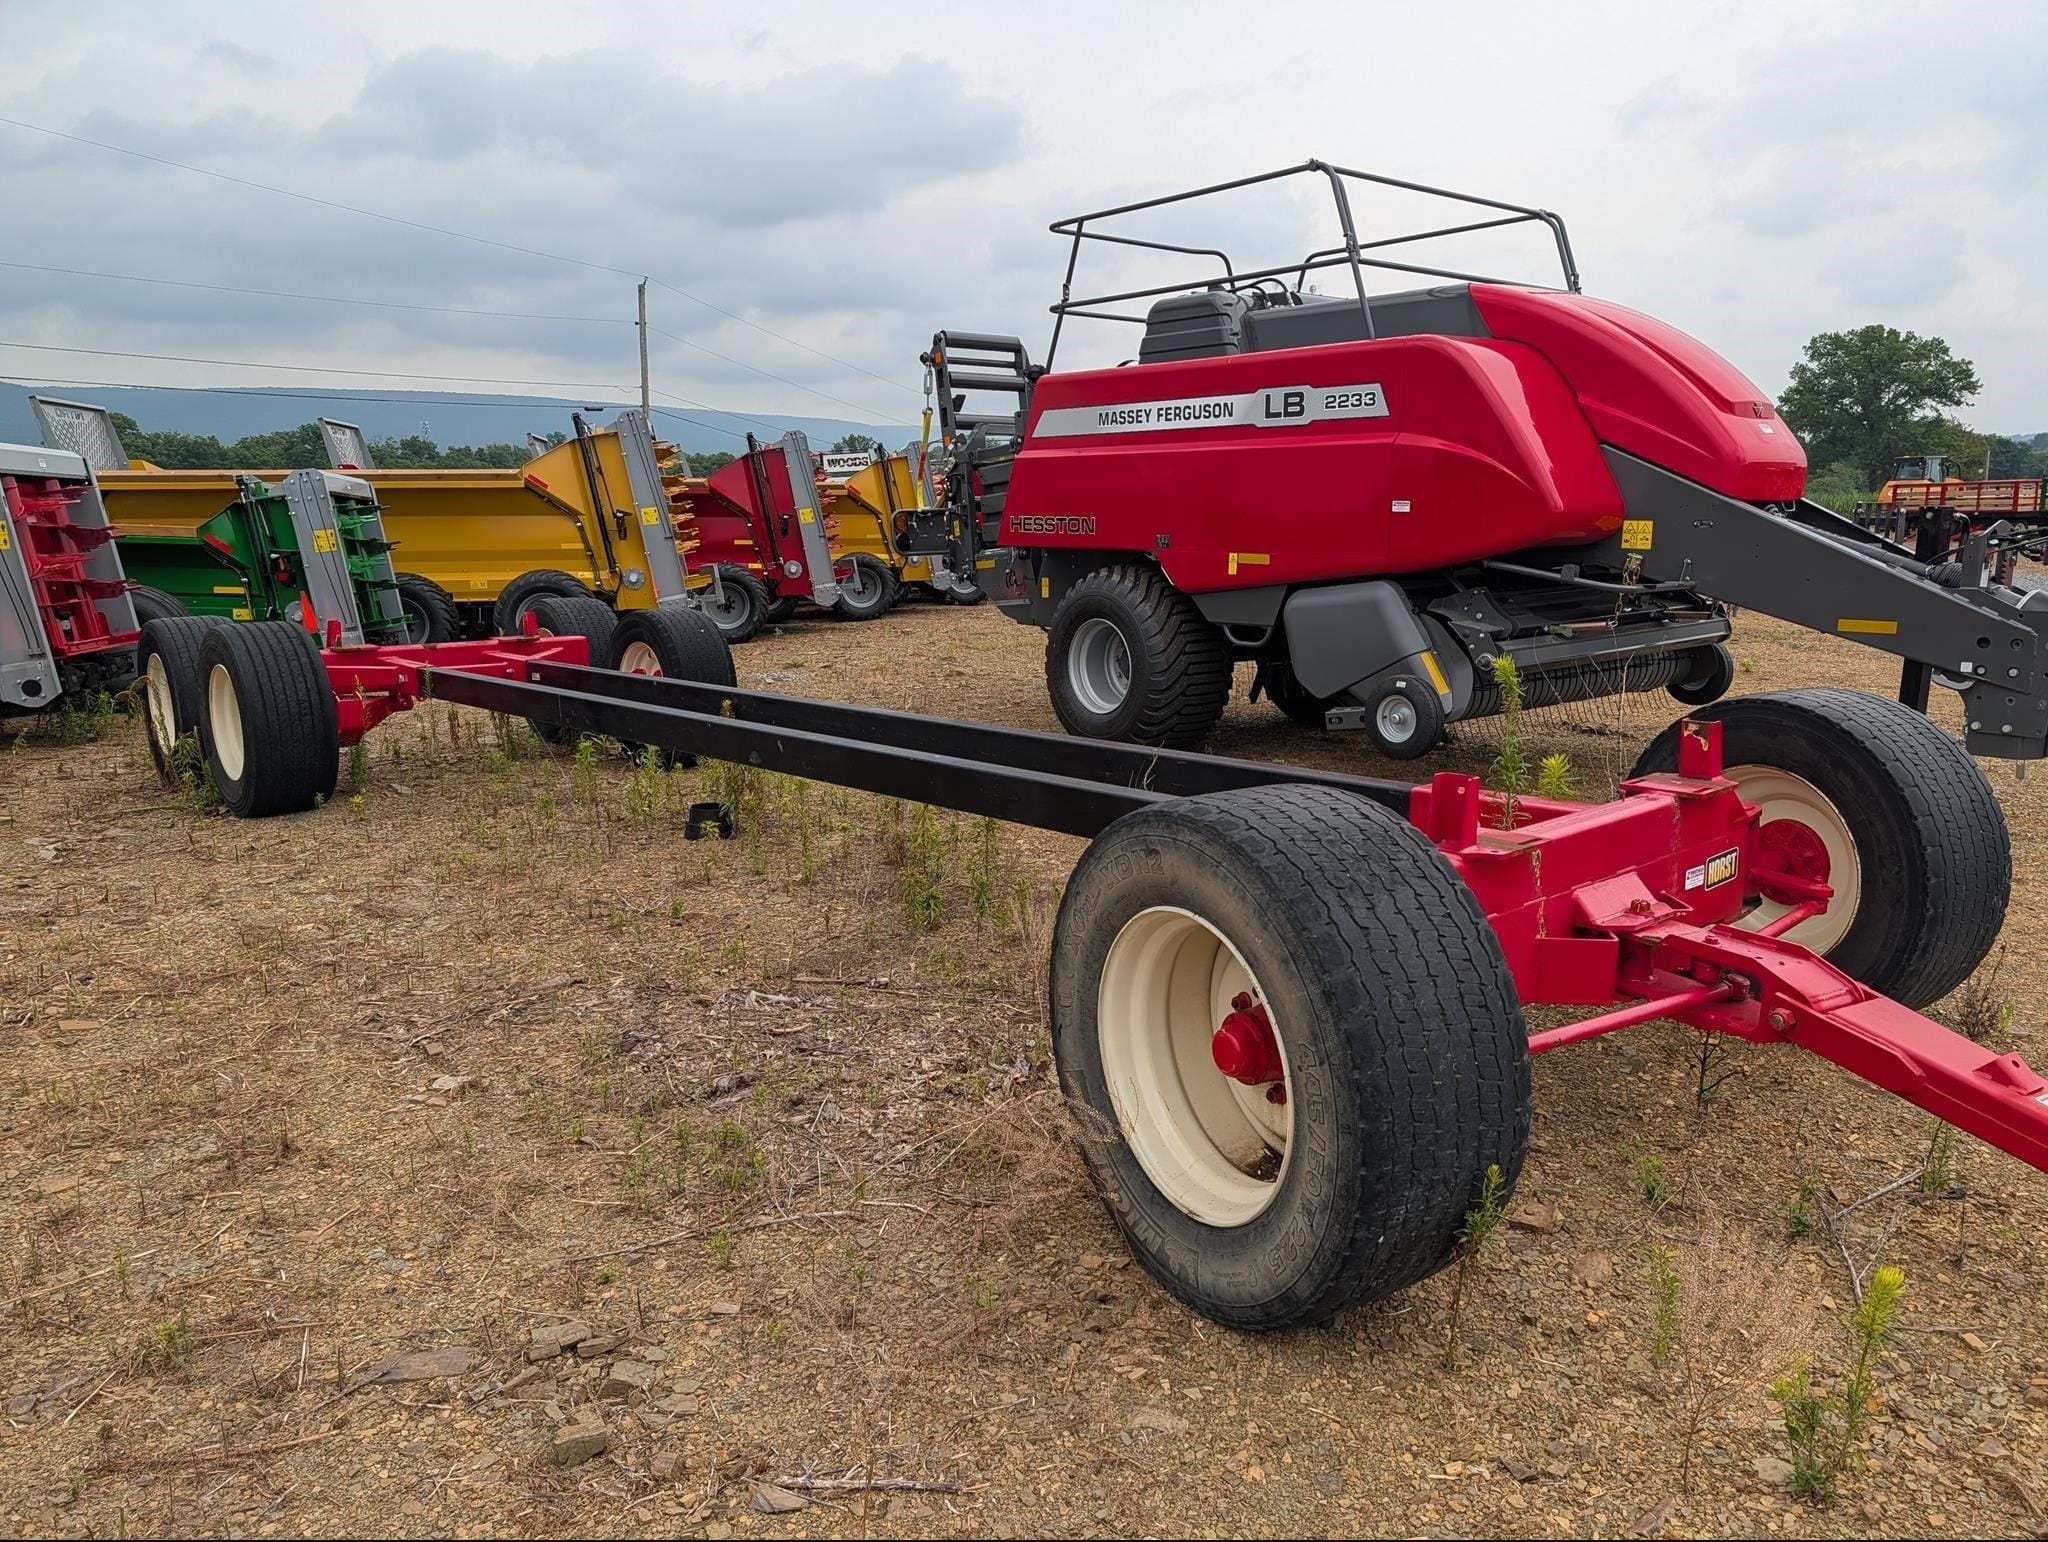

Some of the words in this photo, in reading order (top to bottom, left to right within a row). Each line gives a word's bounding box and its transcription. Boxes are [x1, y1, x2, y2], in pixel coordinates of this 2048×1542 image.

[1098, 408, 1151, 426] MASSEY
[1156, 402, 1234, 423] FERGUSON
[1264, 391, 1306, 420] LB
[1324, 391, 1377, 410] 2233
[827, 457, 869, 468] WOODS
[1009, 516, 1096, 534] HESSTON
[1708, 852, 1737, 885] HORST
